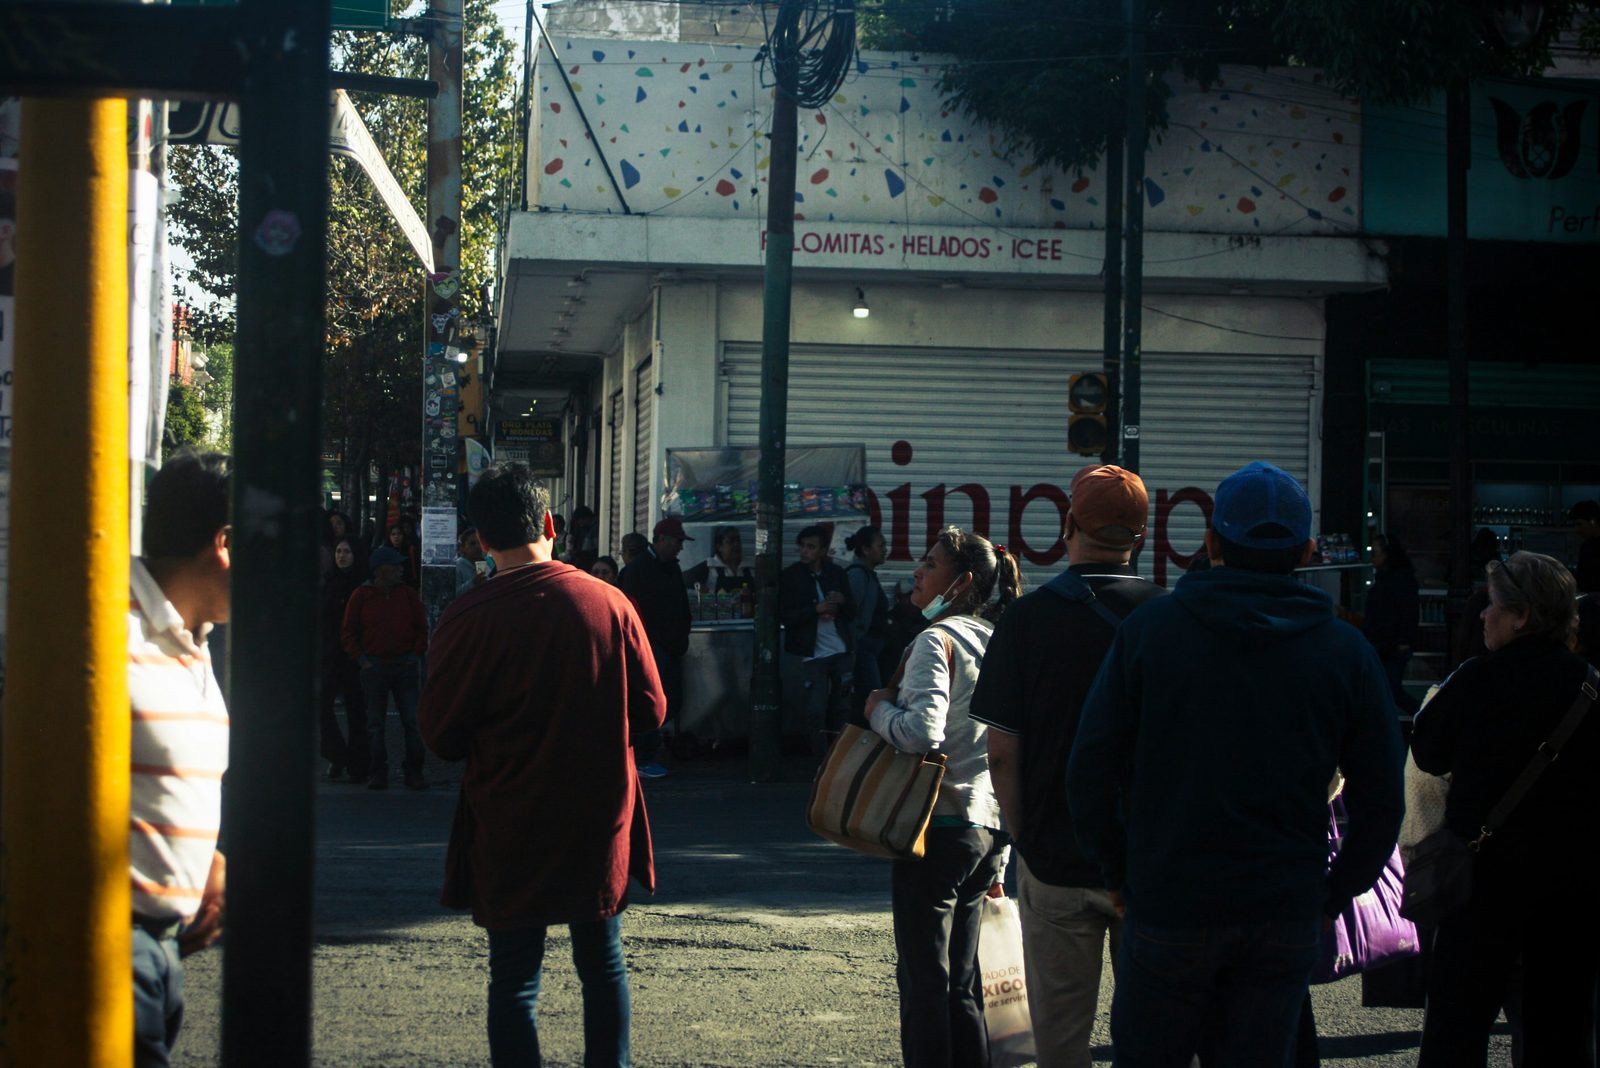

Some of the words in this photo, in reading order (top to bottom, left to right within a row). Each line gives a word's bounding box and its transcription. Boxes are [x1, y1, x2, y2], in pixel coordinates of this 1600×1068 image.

[761, 230, 884, 255] OMITAS
[903, 234, 991, 258] HELADOS
[1011, 238, 1062, 261] ICEE
